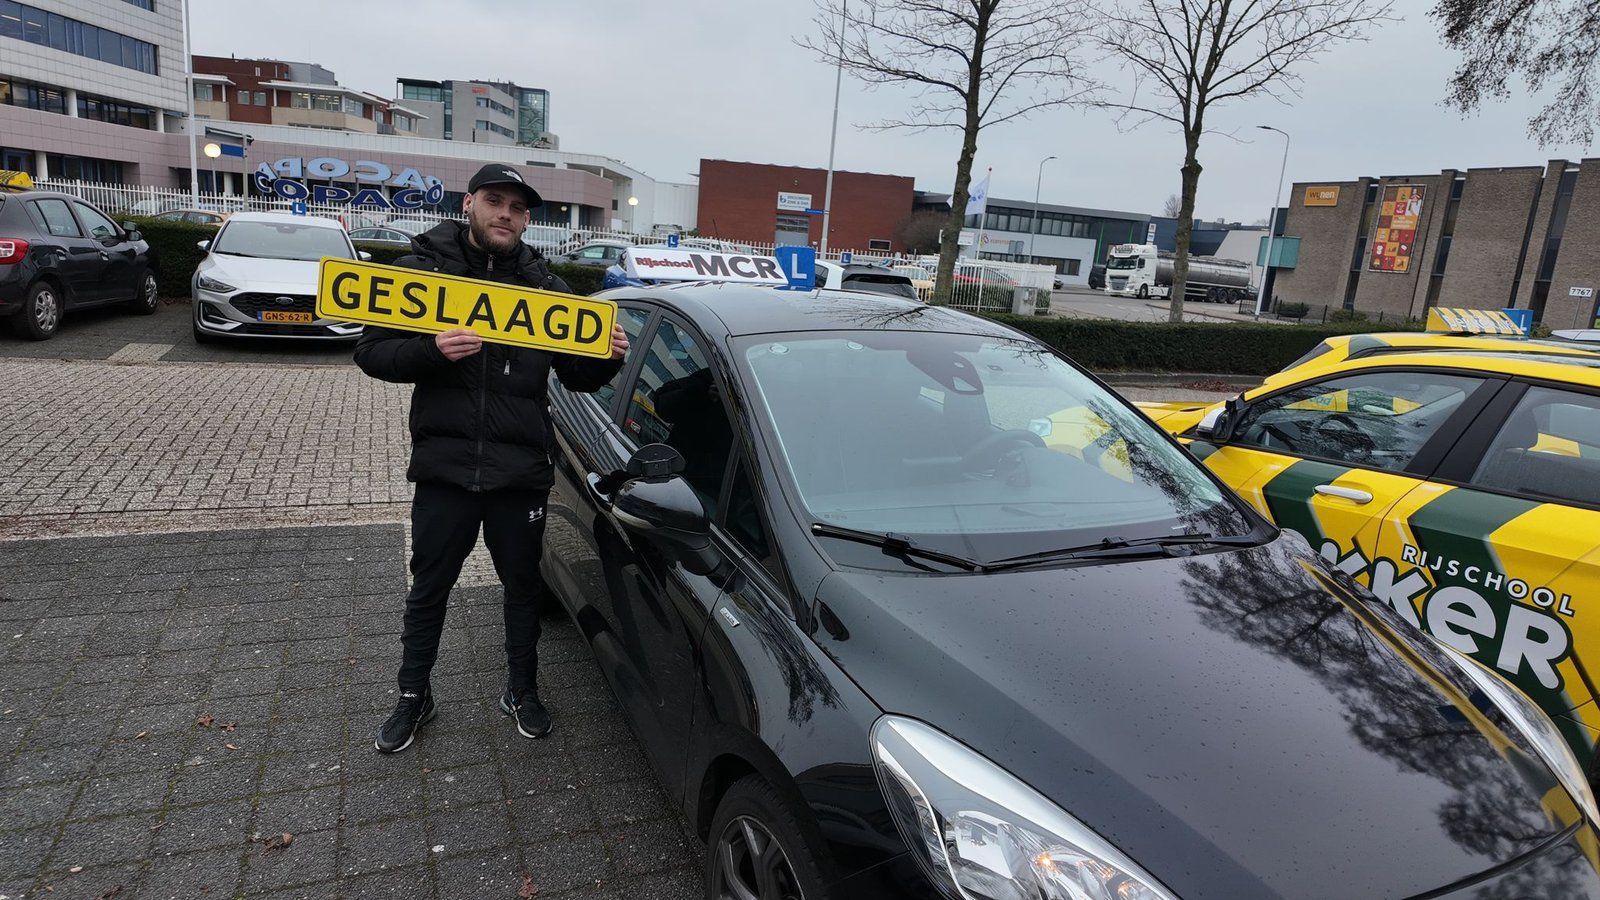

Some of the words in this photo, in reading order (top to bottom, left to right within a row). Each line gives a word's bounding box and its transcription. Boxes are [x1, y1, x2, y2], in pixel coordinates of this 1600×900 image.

[255, 170, 444, 209] COPACO
[295, 204, 303, 213] L
[635, 257, 694, 269] Rijschool
[690, 254, 783, 279] MCR
[791, 253, 807, 279] L
[1571, 288, 1591, 296] 7767
[331, 271, 603, 344] GESLAAGD
[1520, 314, 1528, 331] L
[1402, 544, 1575, 617] RIJSCHOOL
